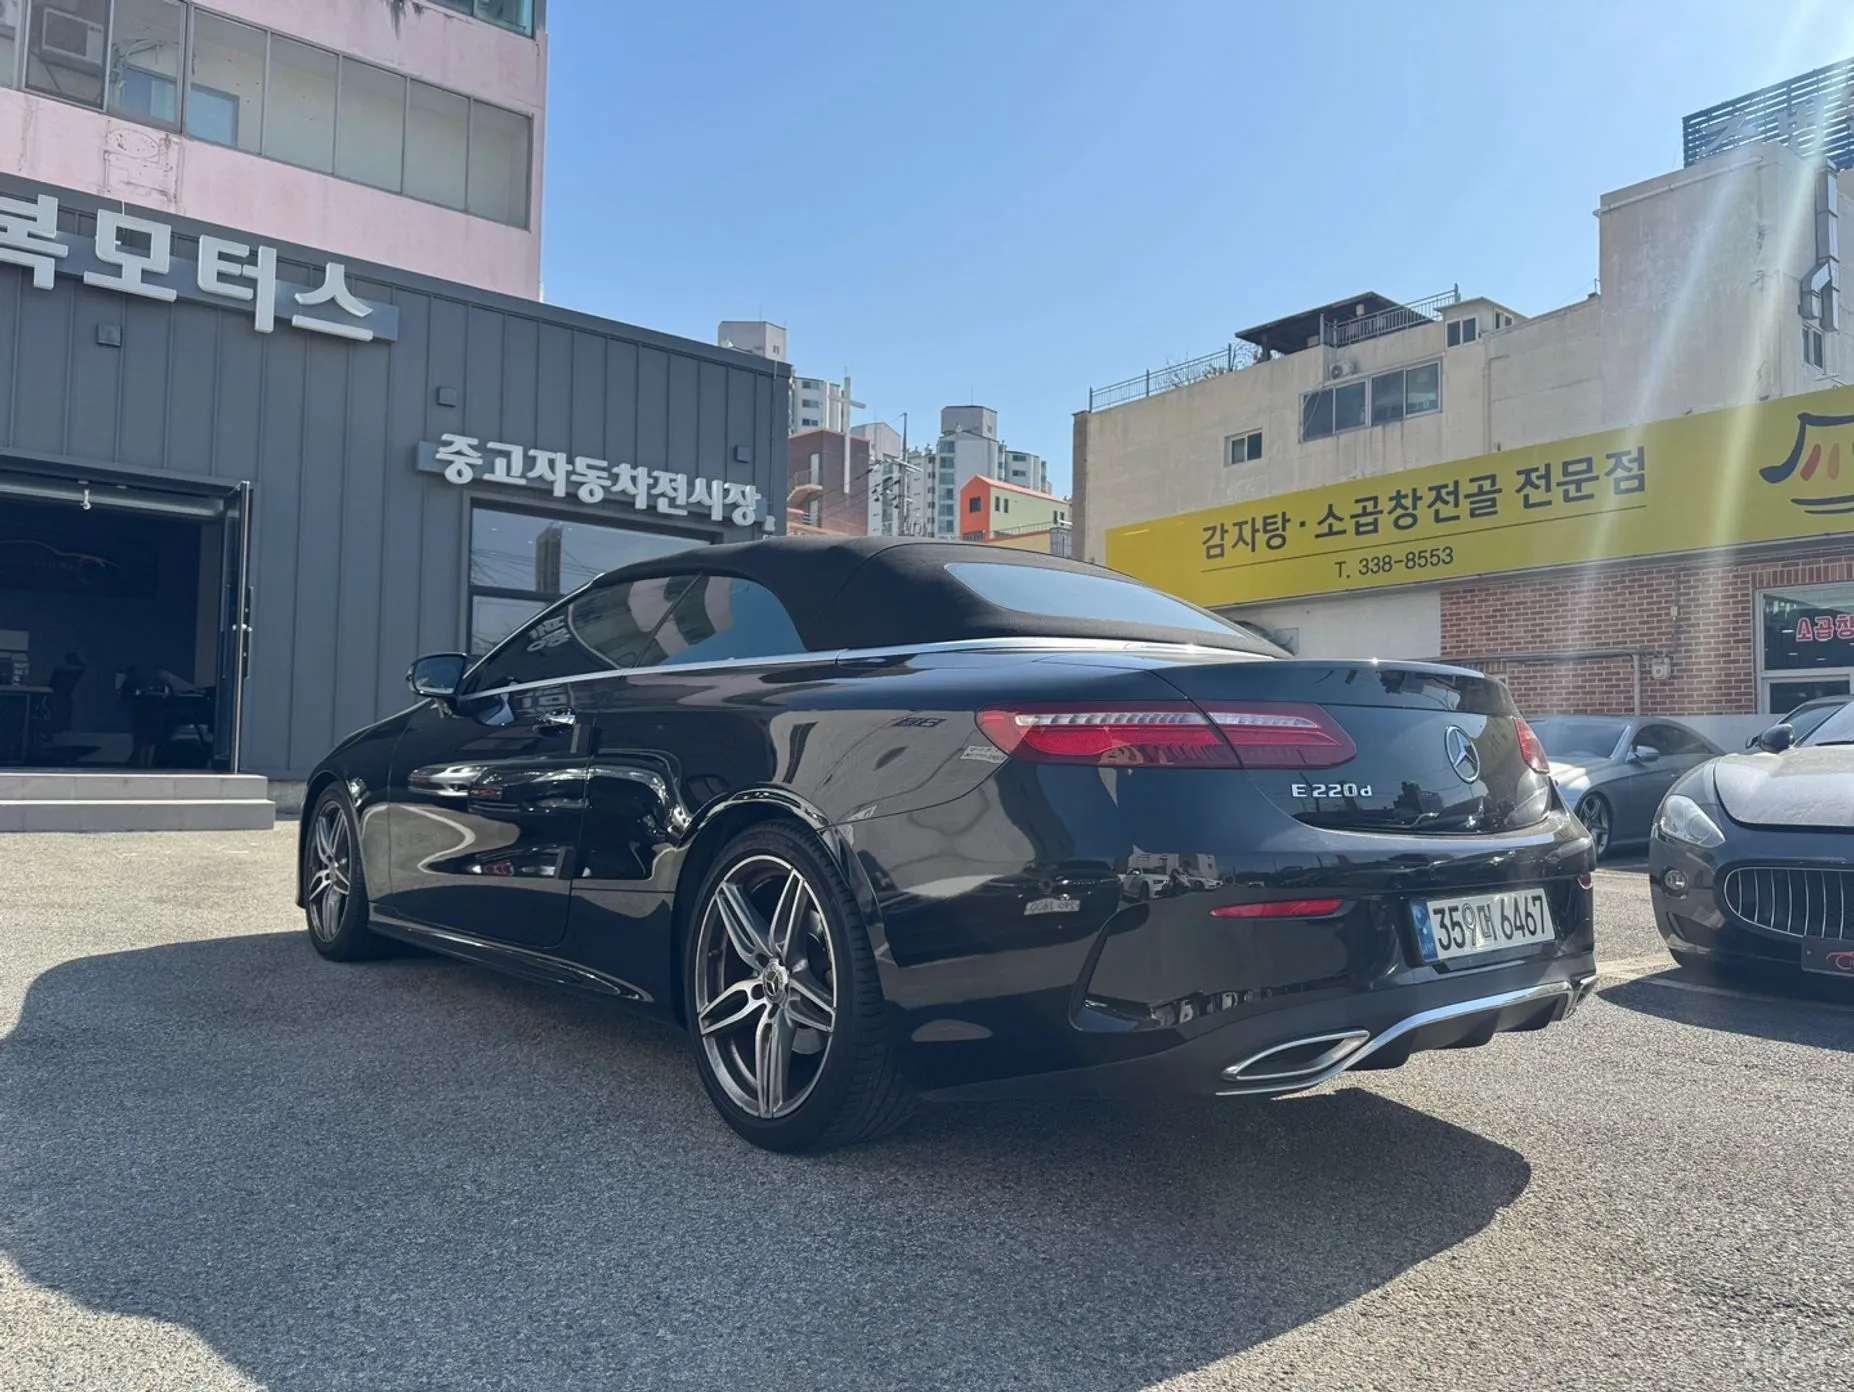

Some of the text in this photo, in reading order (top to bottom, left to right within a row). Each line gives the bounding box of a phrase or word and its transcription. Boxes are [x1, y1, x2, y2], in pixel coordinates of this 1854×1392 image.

[435, 433, 762, 527] 중고자동차전시장
[1514, 446, 1647, 510] 전문점
[1358, 546, 1454, 576] 338-8553
